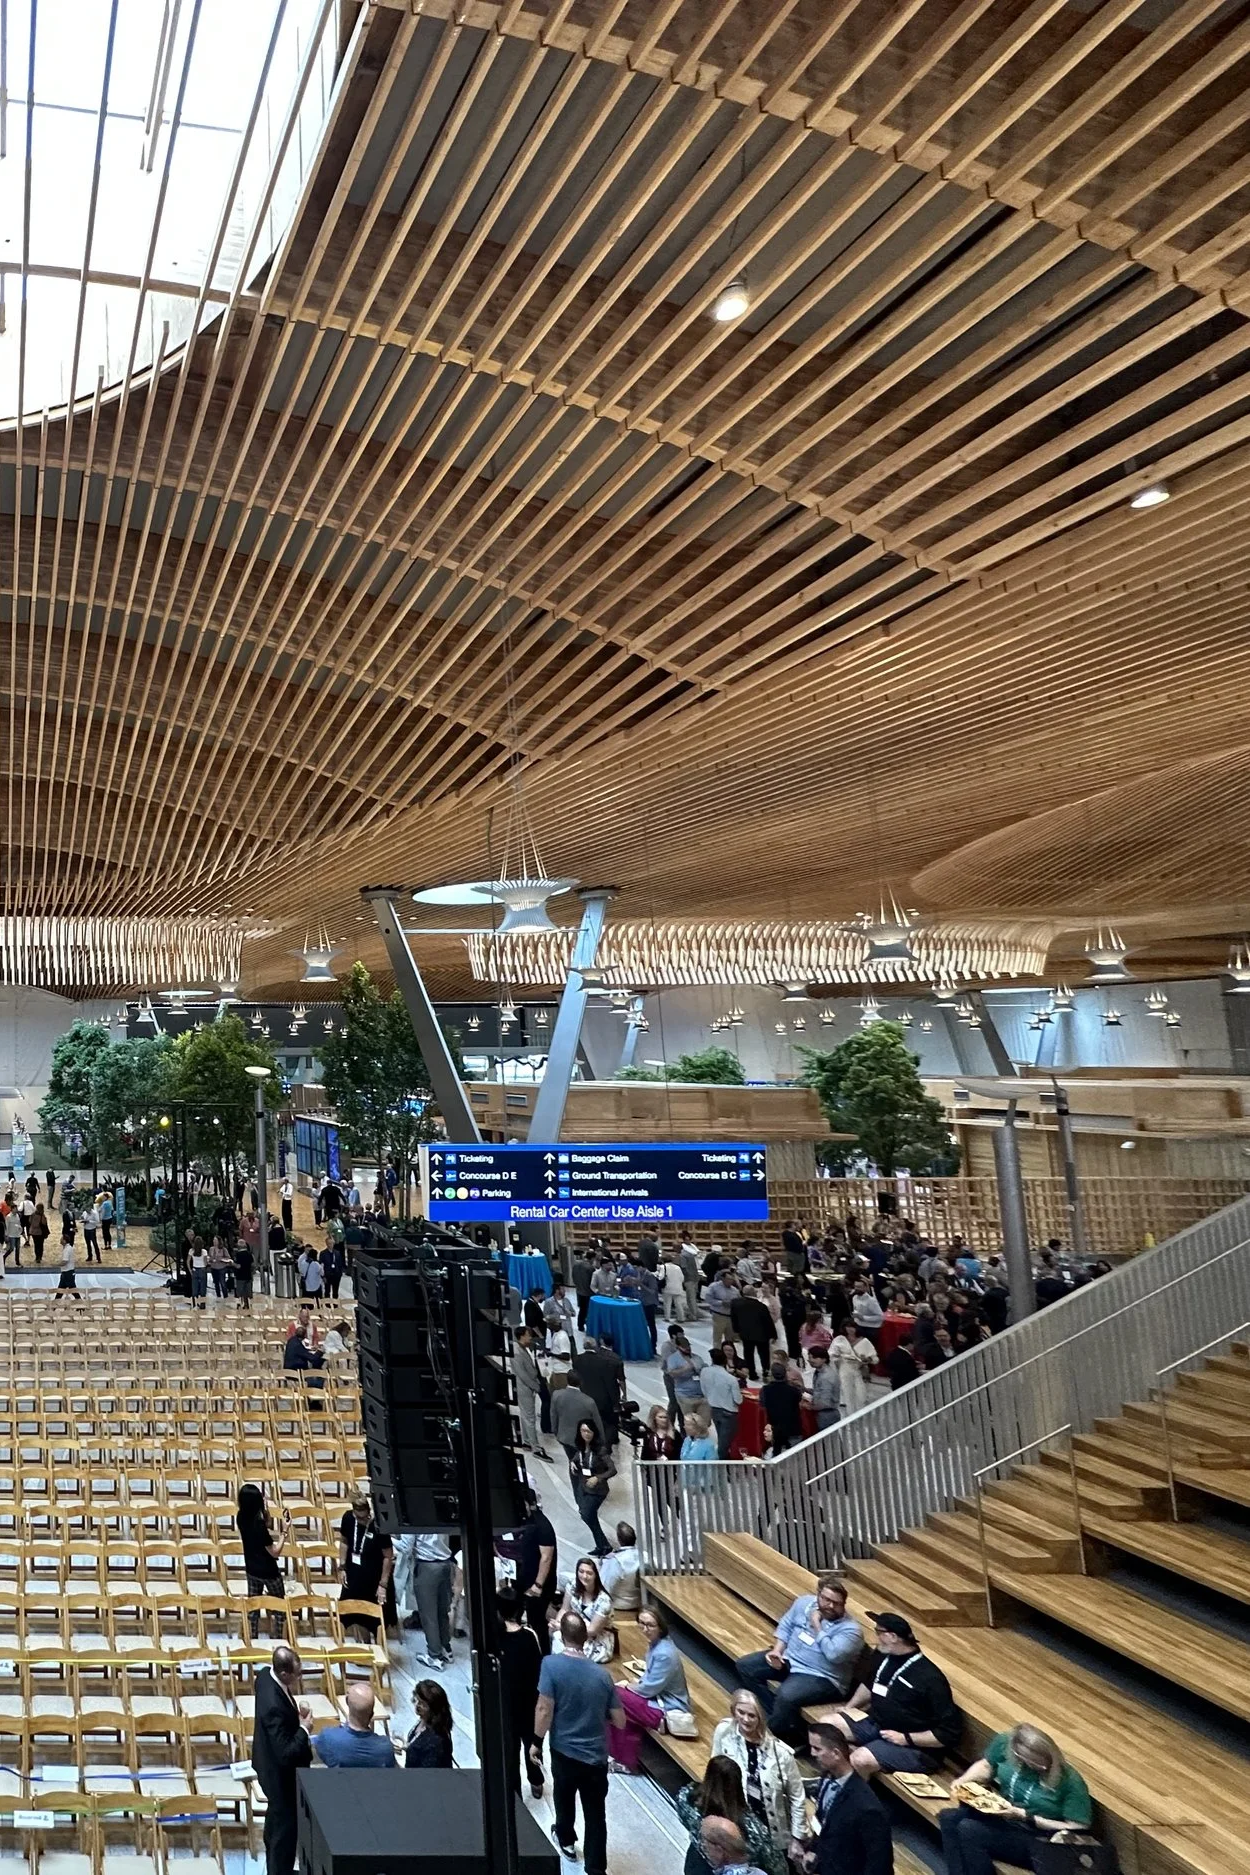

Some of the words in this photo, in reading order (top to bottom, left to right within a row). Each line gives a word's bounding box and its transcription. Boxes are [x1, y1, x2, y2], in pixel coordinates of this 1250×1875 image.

[460, 1155, 494, 1164] Ticketing
[572, 1154, 606, 1164] Baggage
[607, 1154, 629, 1162] Claim
[702, 1154, 736, 1163] Ticketing
[459, 1172, 500, 1180] Concourse
[572, 1172, 601, 1180] Ground
[602, 1172, 658, 1180] Transportation
[678, 1172, 720, 1180] Concourse
[730, 1172, 737, 1180] C
[482, 1189, 512, 1198] Parking
[572, 1188, 618, 1197] International
[620, 1189, 649, 1197] Arrivals
[510, 1206, 546, 1218] Rental
[548, 1206, 570, 1218] Car
[572, 1206, 609, 1218] Center
[612, 1206, 634, 1218] Use
[636, 1205, 664, 1218] Aisle
[666, 1206, 672, 1216] 1
